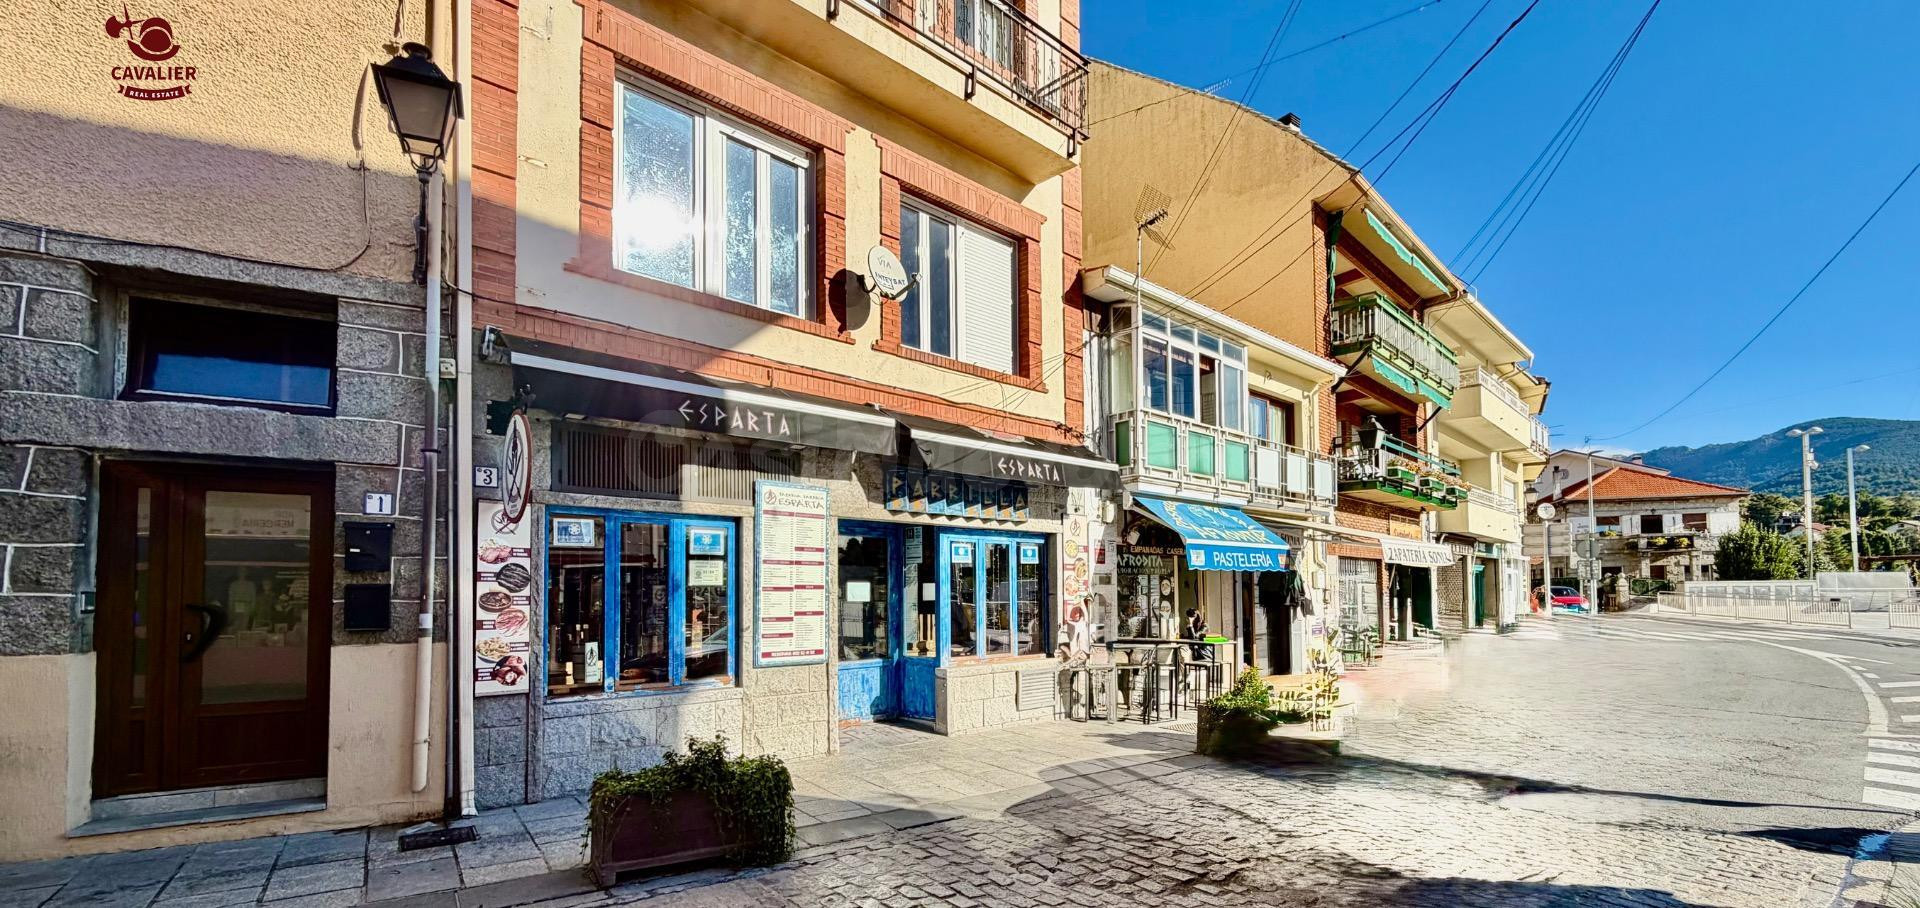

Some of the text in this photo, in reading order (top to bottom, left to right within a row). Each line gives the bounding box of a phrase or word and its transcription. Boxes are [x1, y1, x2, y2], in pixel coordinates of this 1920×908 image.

[679, 400, 792, 436] ESPARTA
[483, 468, 493, 485] 3
[997, 456, 1061, 482] ESPARTA
[890, 476, 1026, 508] PARRILLA
[377, 495, 385, 513] 1
[778, 498, 825, 510] ESPARTA
[1167, 548, 1186, 556] CASER
[1213, 551, 1275, 567] PASTELERÍA
